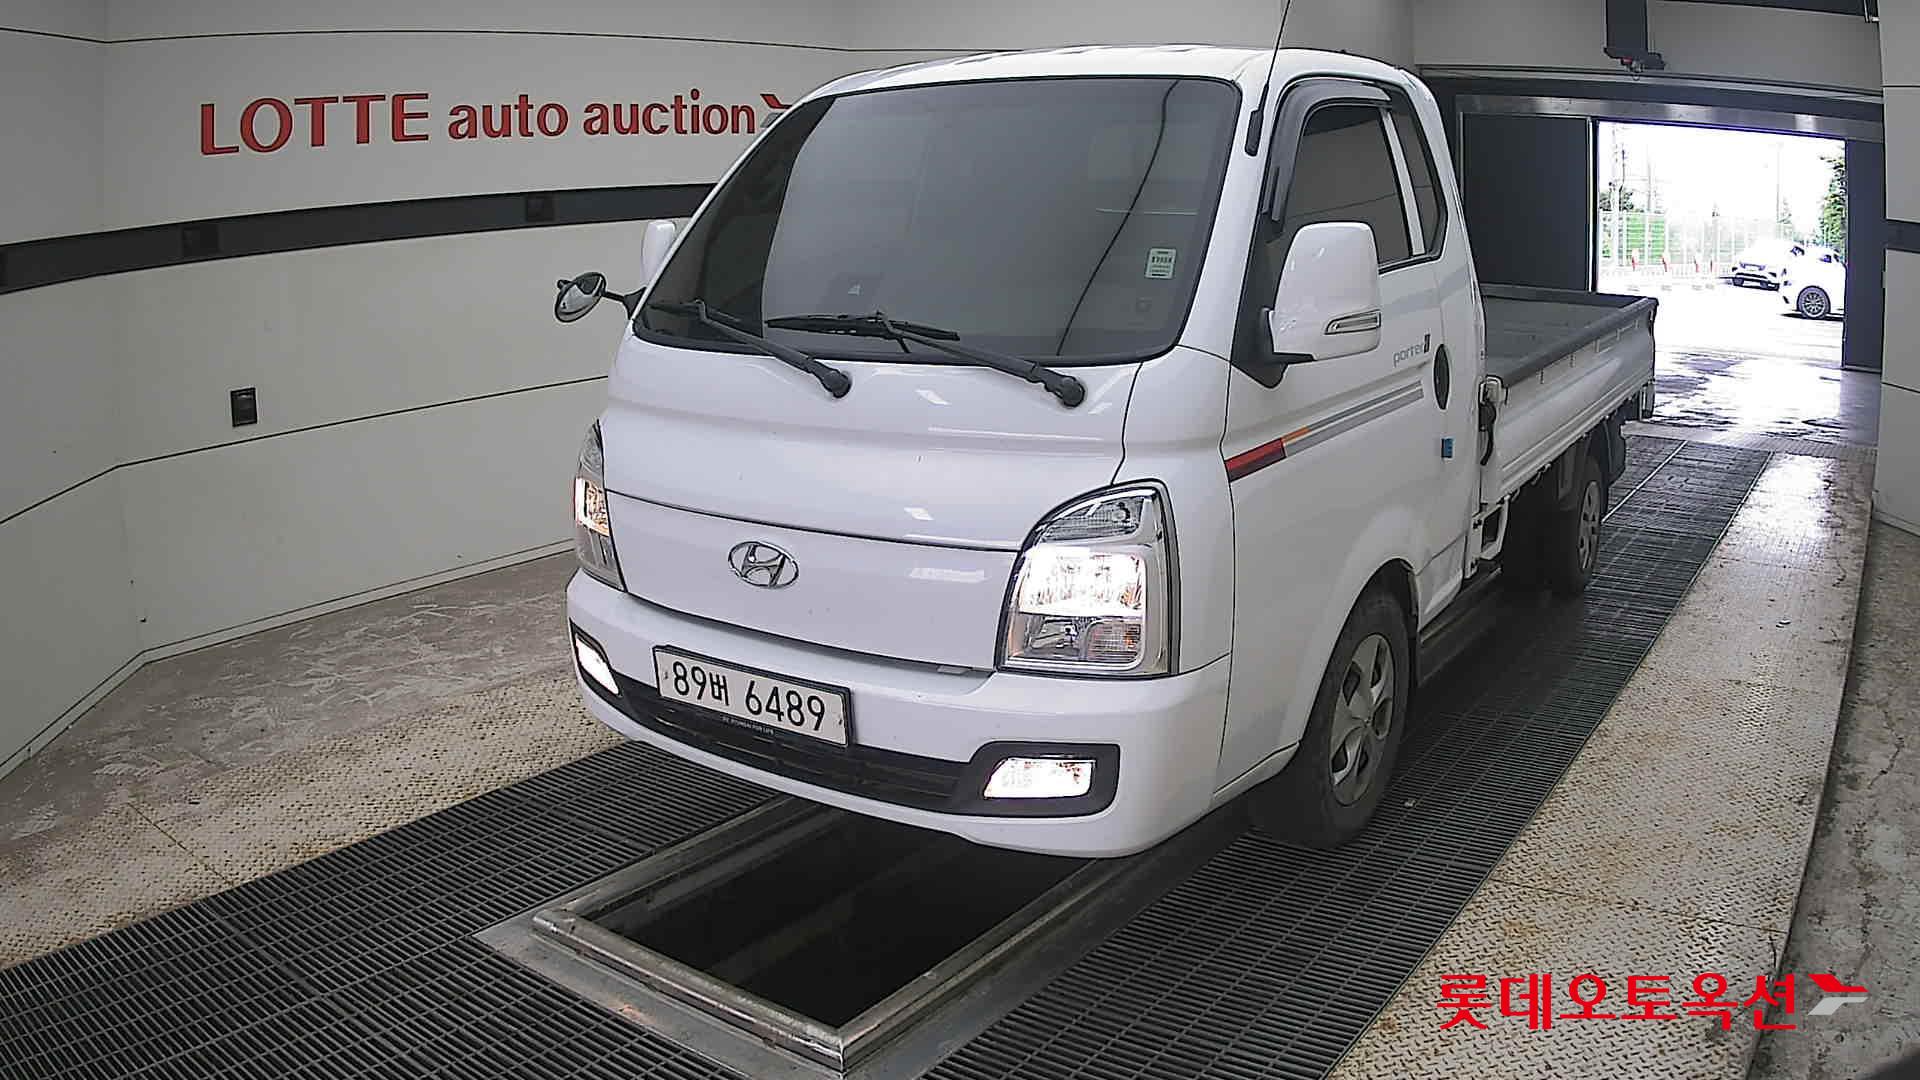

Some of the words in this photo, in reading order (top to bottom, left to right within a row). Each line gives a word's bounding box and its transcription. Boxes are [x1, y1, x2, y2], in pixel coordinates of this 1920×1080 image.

[200, 93, 429, 155] LOTTE
[448, 94, 569, 140] auto
[583, 89, 755, 136] auction
[673, 661, 730, 706] 89버
[745, 681, 825, 731] 6489
